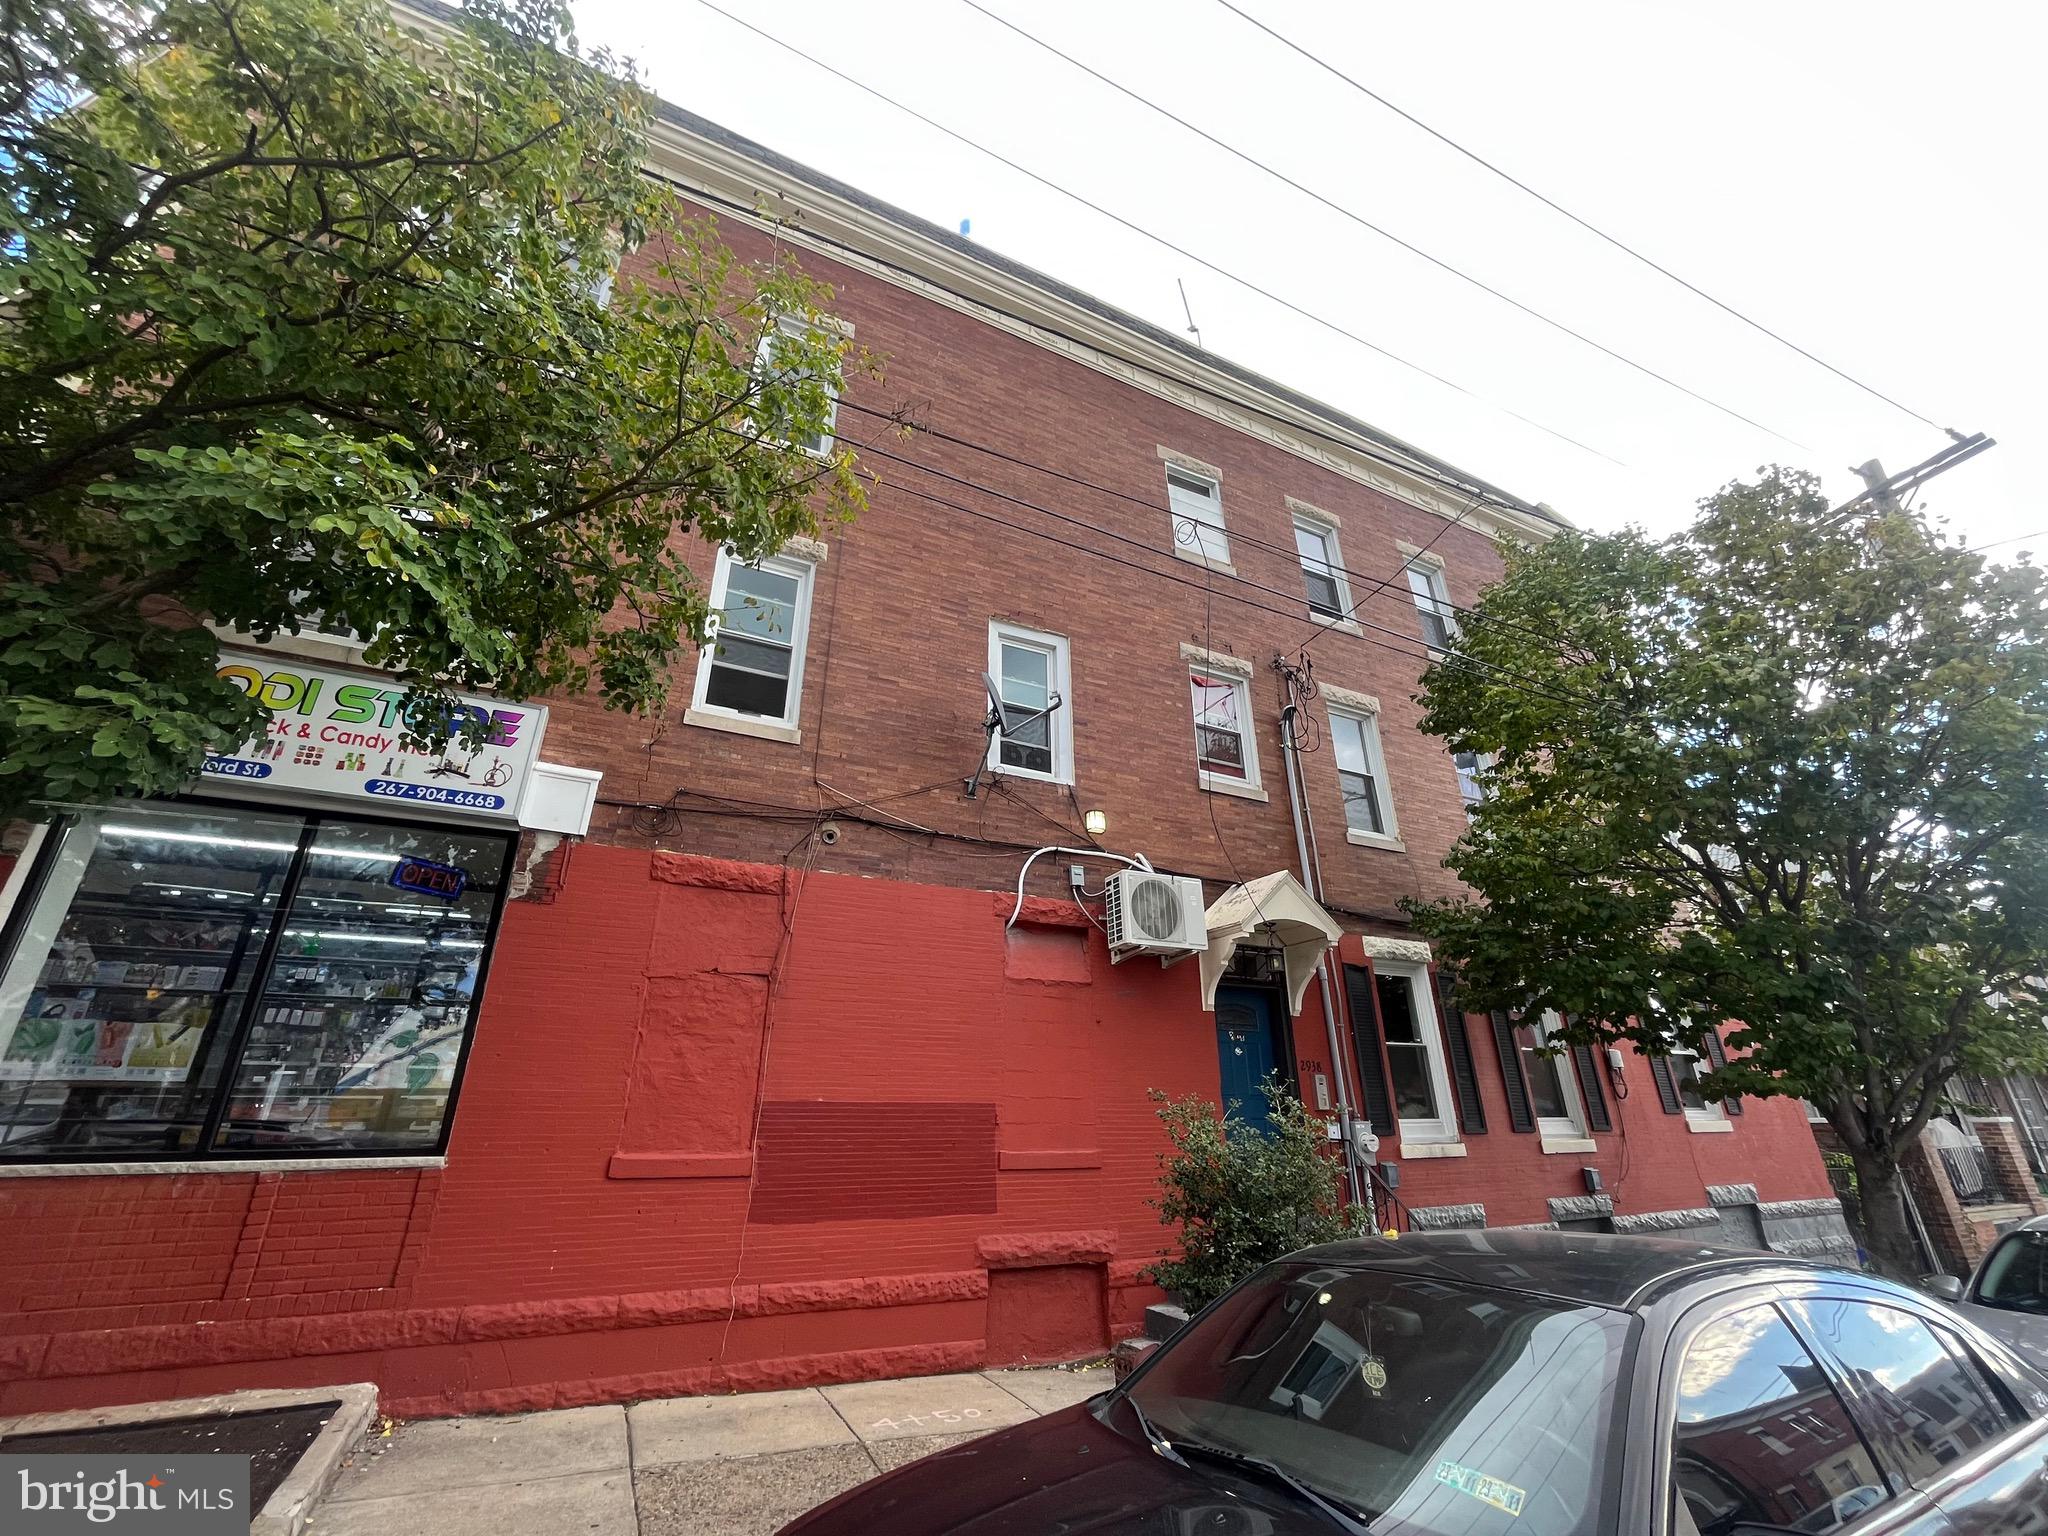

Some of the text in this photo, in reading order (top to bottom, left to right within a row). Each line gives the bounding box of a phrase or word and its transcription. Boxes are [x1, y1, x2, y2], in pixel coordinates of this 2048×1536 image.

[296, 722, 311, 739] &
[320, 725, 394, 754] Candy
[242, 763, 263, 777] St.
[374, 781, 496, 808] 267-904-6668
[403, 864, 458, 891] OPEN
[1300, 1060, 1322, 1073] 2938
